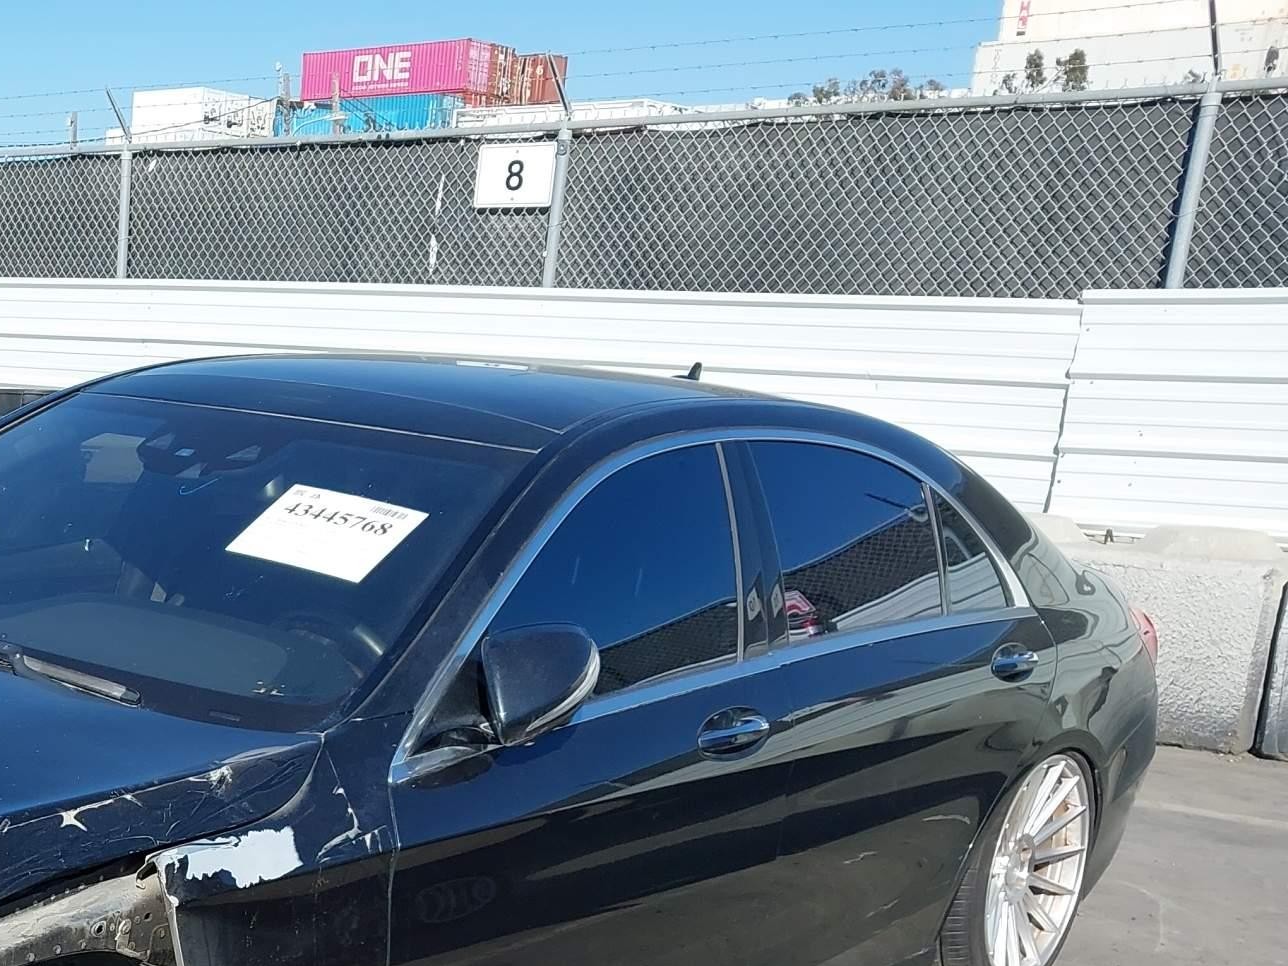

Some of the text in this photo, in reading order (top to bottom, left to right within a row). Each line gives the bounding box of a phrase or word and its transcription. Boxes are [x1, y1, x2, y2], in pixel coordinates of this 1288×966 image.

[352, 51, 411, 82] ONE
[505, 160, 524, 191] 8
[284, 503, 393, 535] 43445768
